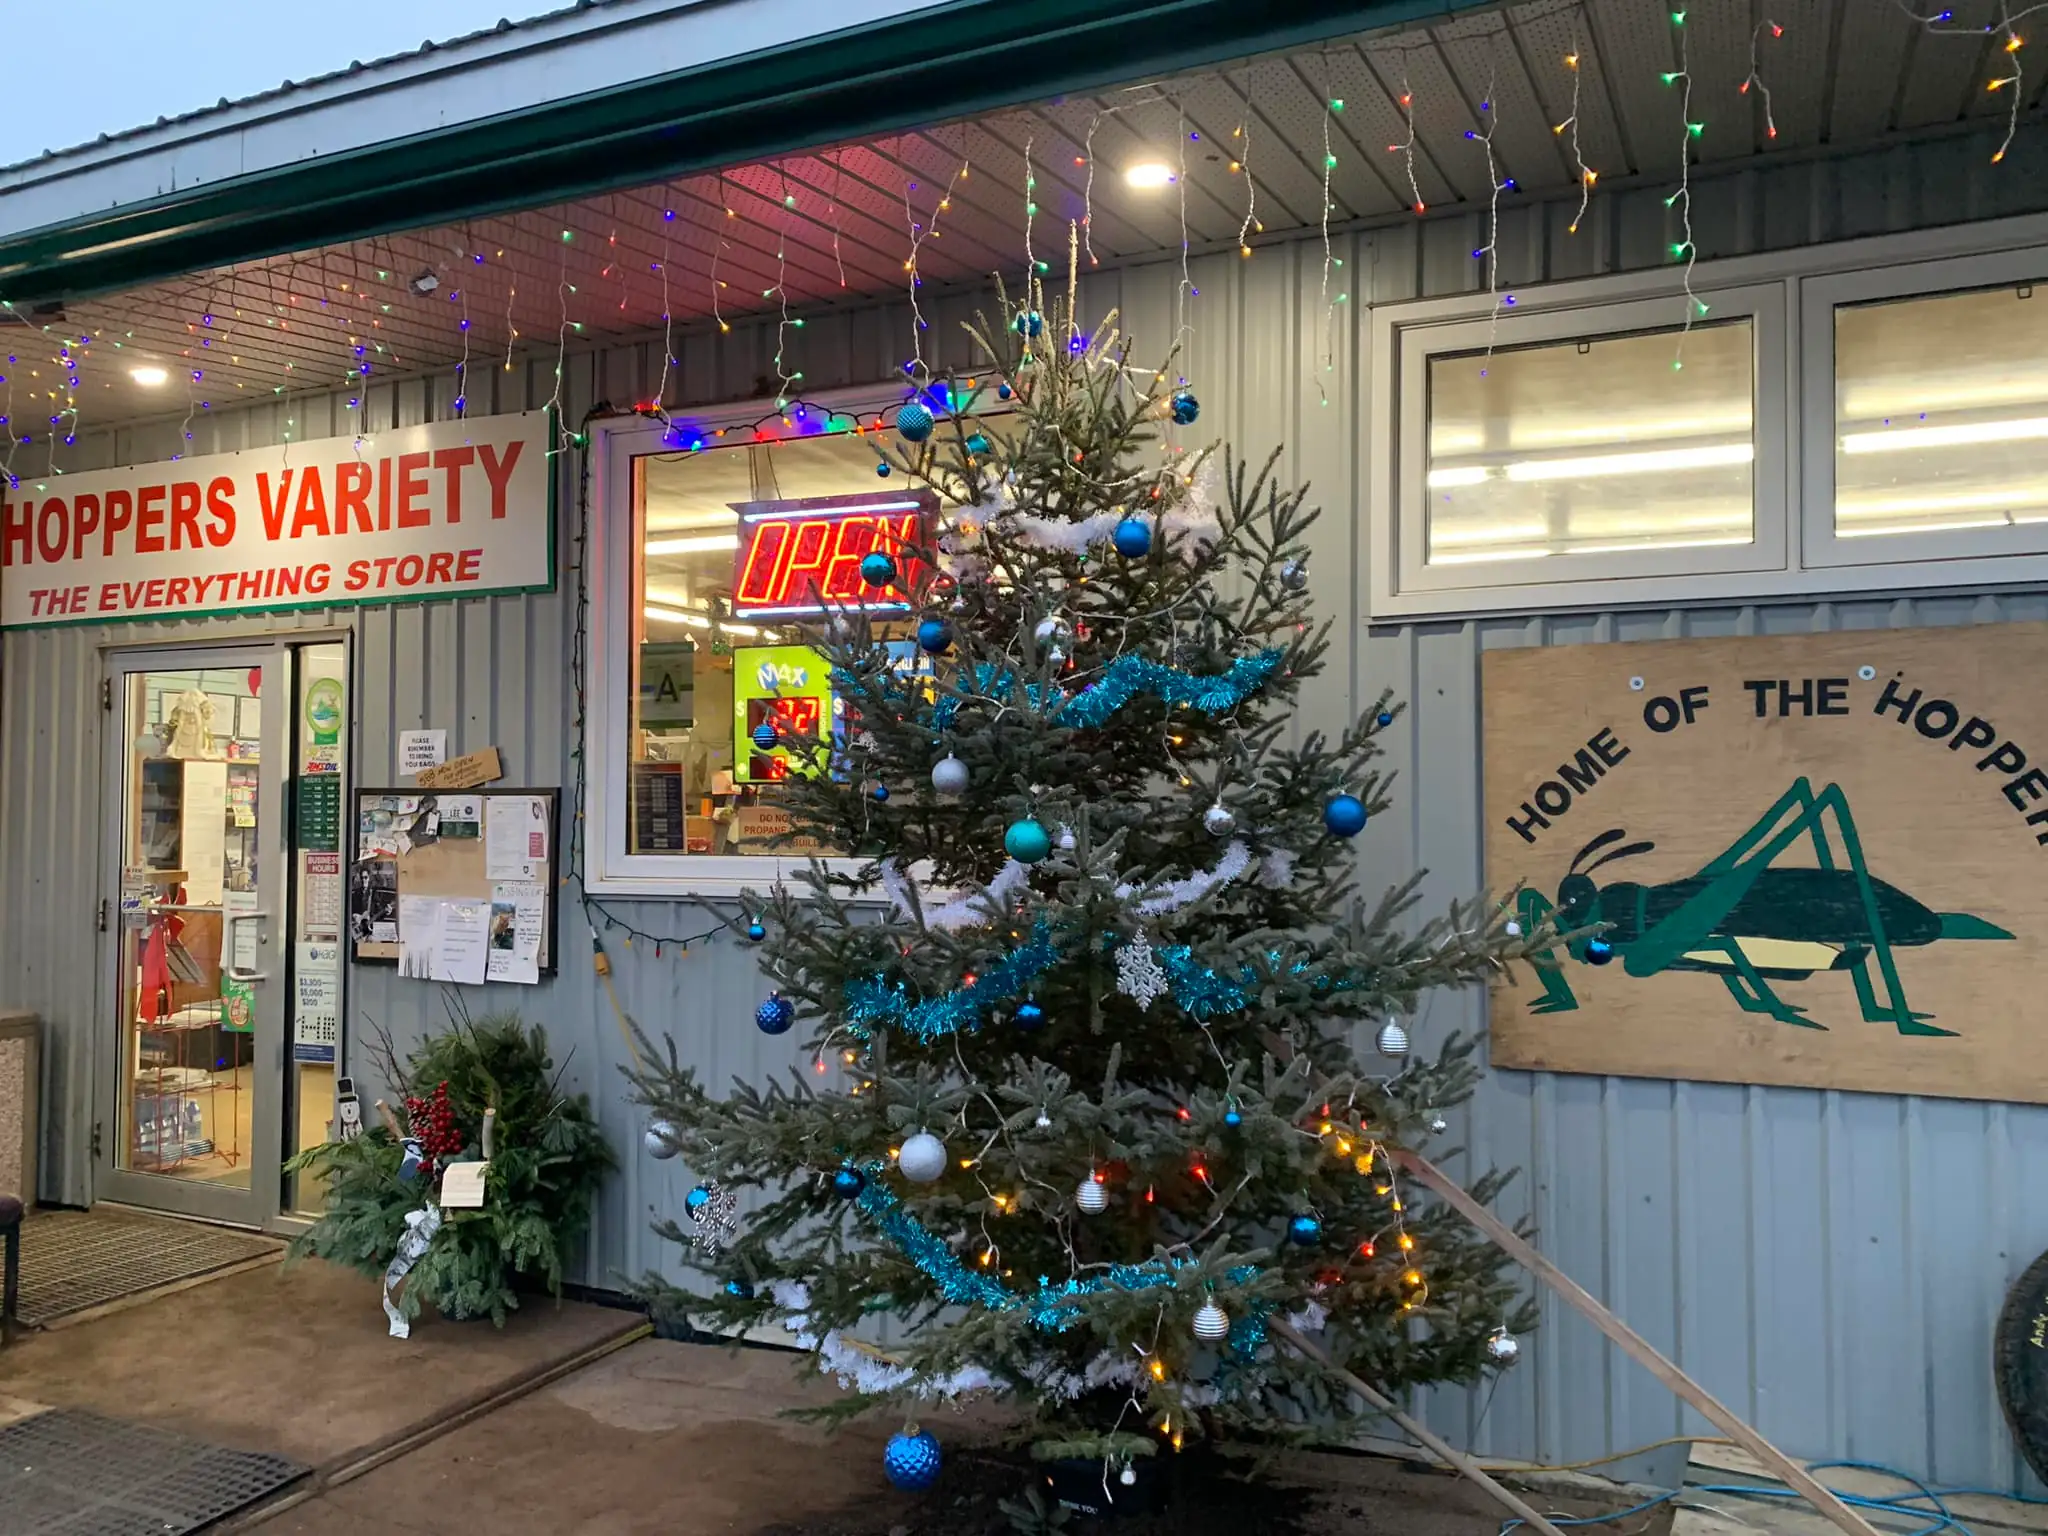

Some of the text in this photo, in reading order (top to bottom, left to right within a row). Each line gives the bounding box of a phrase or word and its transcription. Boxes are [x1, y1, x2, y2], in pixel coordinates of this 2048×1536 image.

[3, 441, 525, 567] HOPPERS VARIETY
[29, 548, 484, 617] THE EVERYTHING STORE
[737, 514, 915, 603] OPEN
[655, 672, 678, 702] A
[757, 662, 808, 690] MAX
[1505, 726, 1632, 844] HOME
[1643, 686, 1710, 733] OF
[1743, 678, 1850, 717] THE
[760, 814, 773, 823] DO
